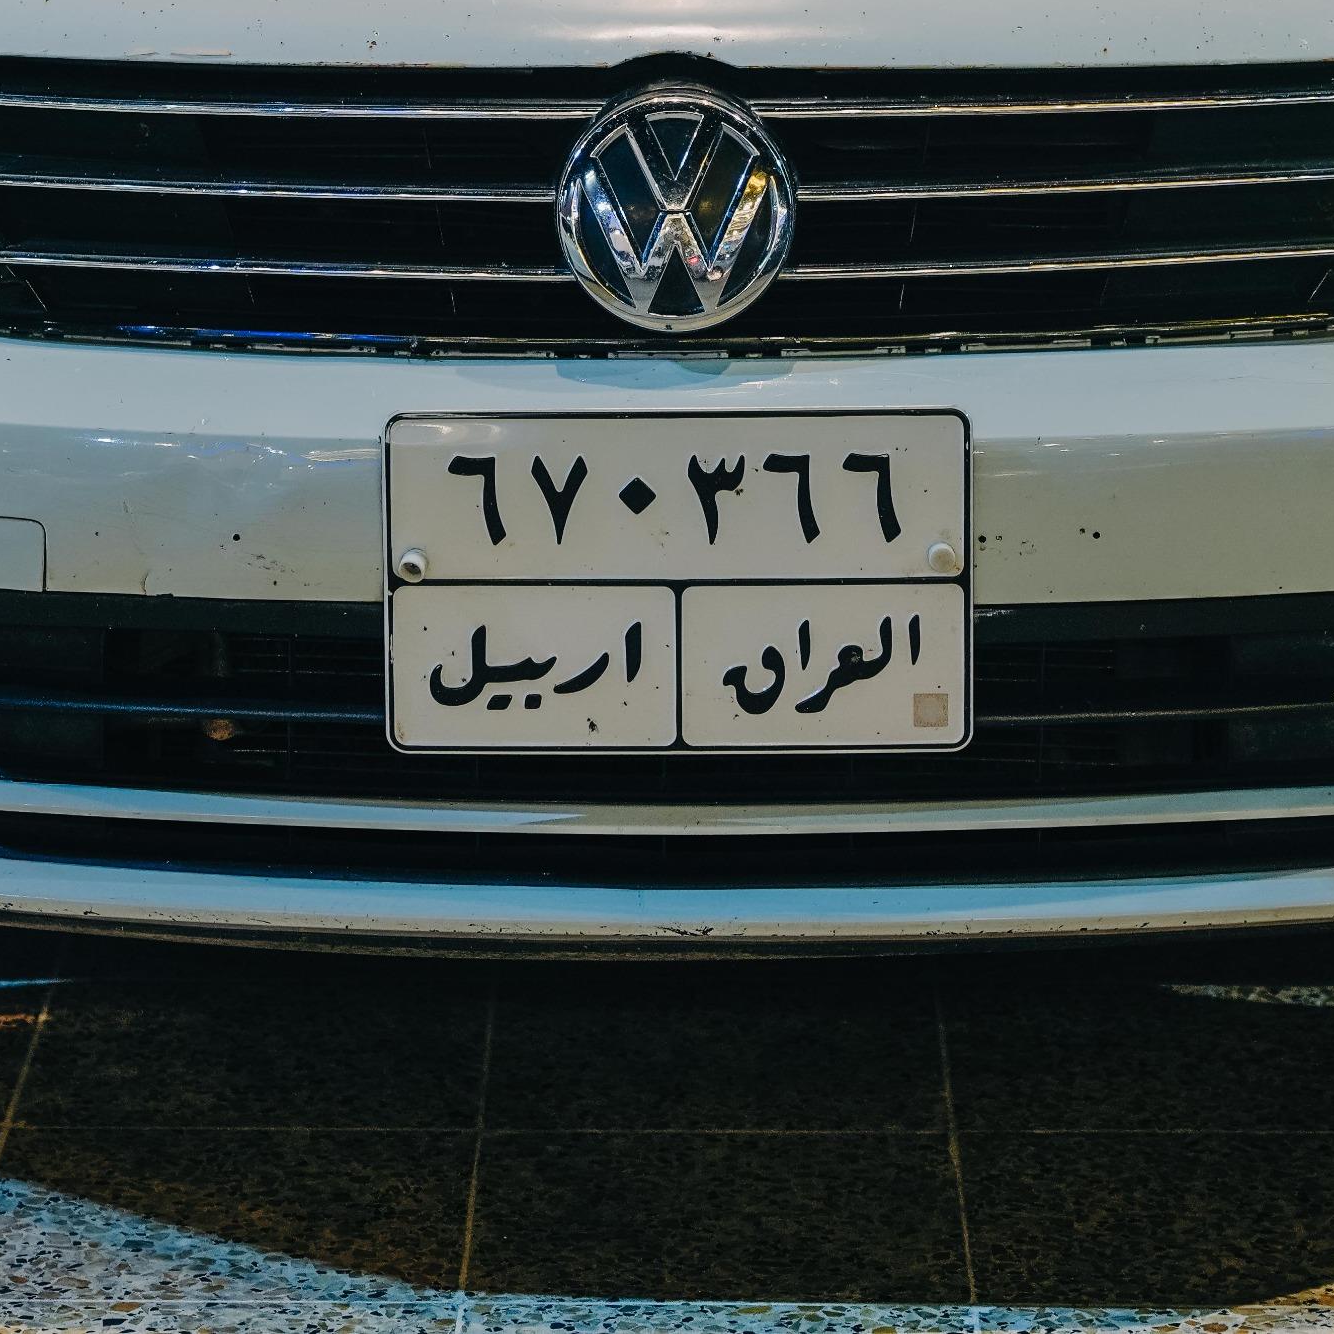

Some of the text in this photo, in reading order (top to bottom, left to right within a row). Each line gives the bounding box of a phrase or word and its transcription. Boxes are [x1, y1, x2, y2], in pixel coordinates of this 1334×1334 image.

[568, 101, 785, 322] VW
[446, 451, 903, 547] ٦٧٠٣٦٦
[428, 620, 643, 712] اربيل
[721, 613, 922, 716] العراق
